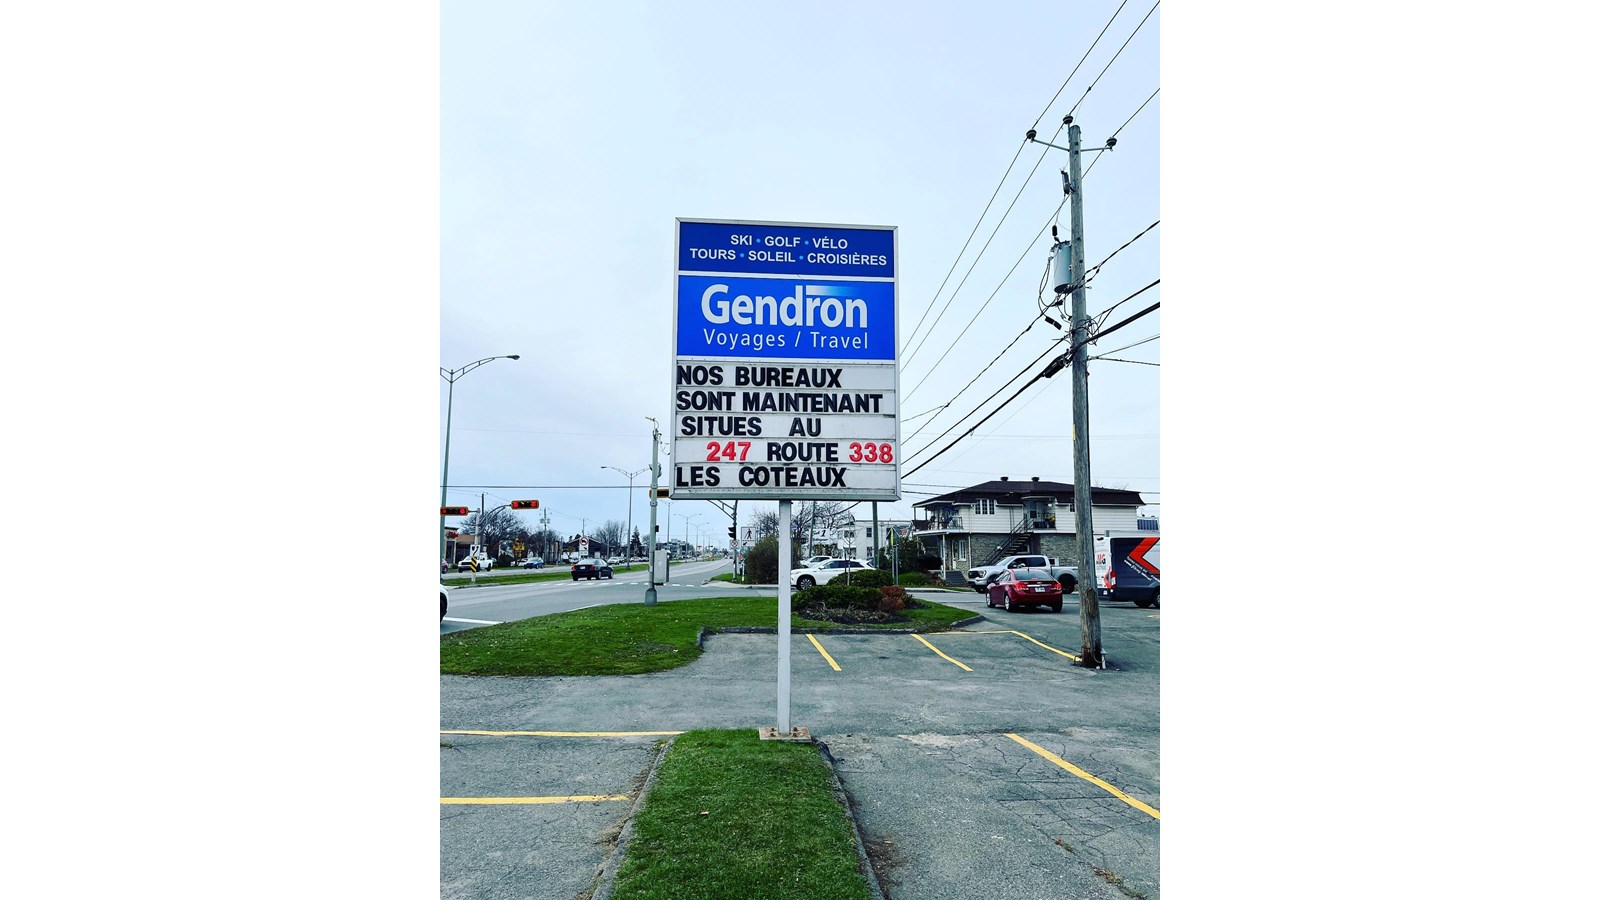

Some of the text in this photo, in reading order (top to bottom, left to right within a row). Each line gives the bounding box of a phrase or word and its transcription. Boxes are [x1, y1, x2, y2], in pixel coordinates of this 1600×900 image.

[730, 234, 848, 250] SKI GOLF VÉLO
[689, 248, 887, 266] TOURS SOLEIL CROISIÈRES
[701, 284, 868, 329] Gendron
[703, 328, 786, 351] Voyages
[810, 331, 868, 349] Travel
[677, 365, 843, 388] NOS BUREAUX
[677, 390, 883, 413] SONT MAINTENANT
[681, 416, 822, 437] SITUES AU
[706, 441, 893, 463] 247 ROUTE 338
[676, 466, 847, 487] LES COTEAUX
